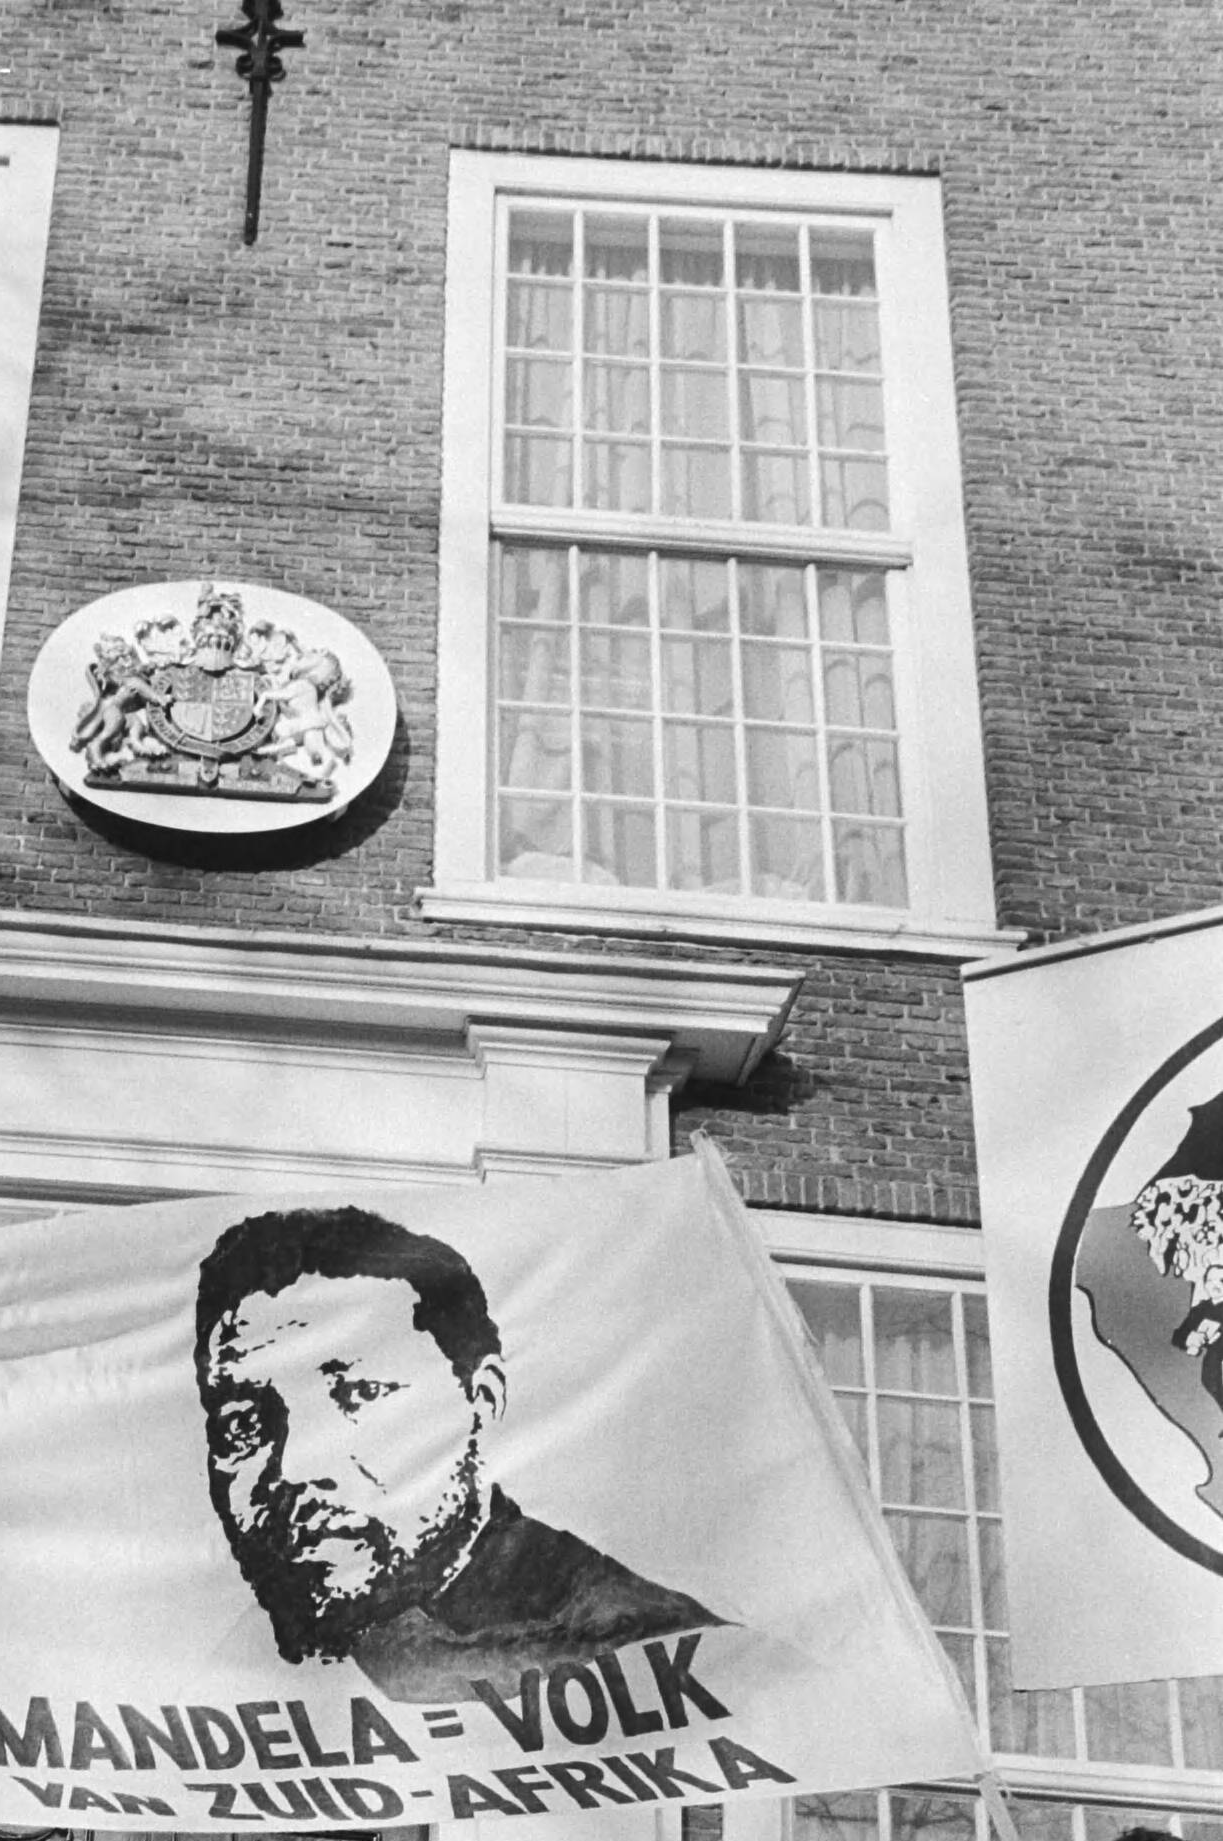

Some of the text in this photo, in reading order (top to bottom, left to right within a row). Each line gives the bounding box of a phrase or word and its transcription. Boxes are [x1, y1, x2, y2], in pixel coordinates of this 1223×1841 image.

[469, 1632, 733, 1753] VOLK
[9, 1735, 799, 1821] VAN ZUID-AFRIKA
